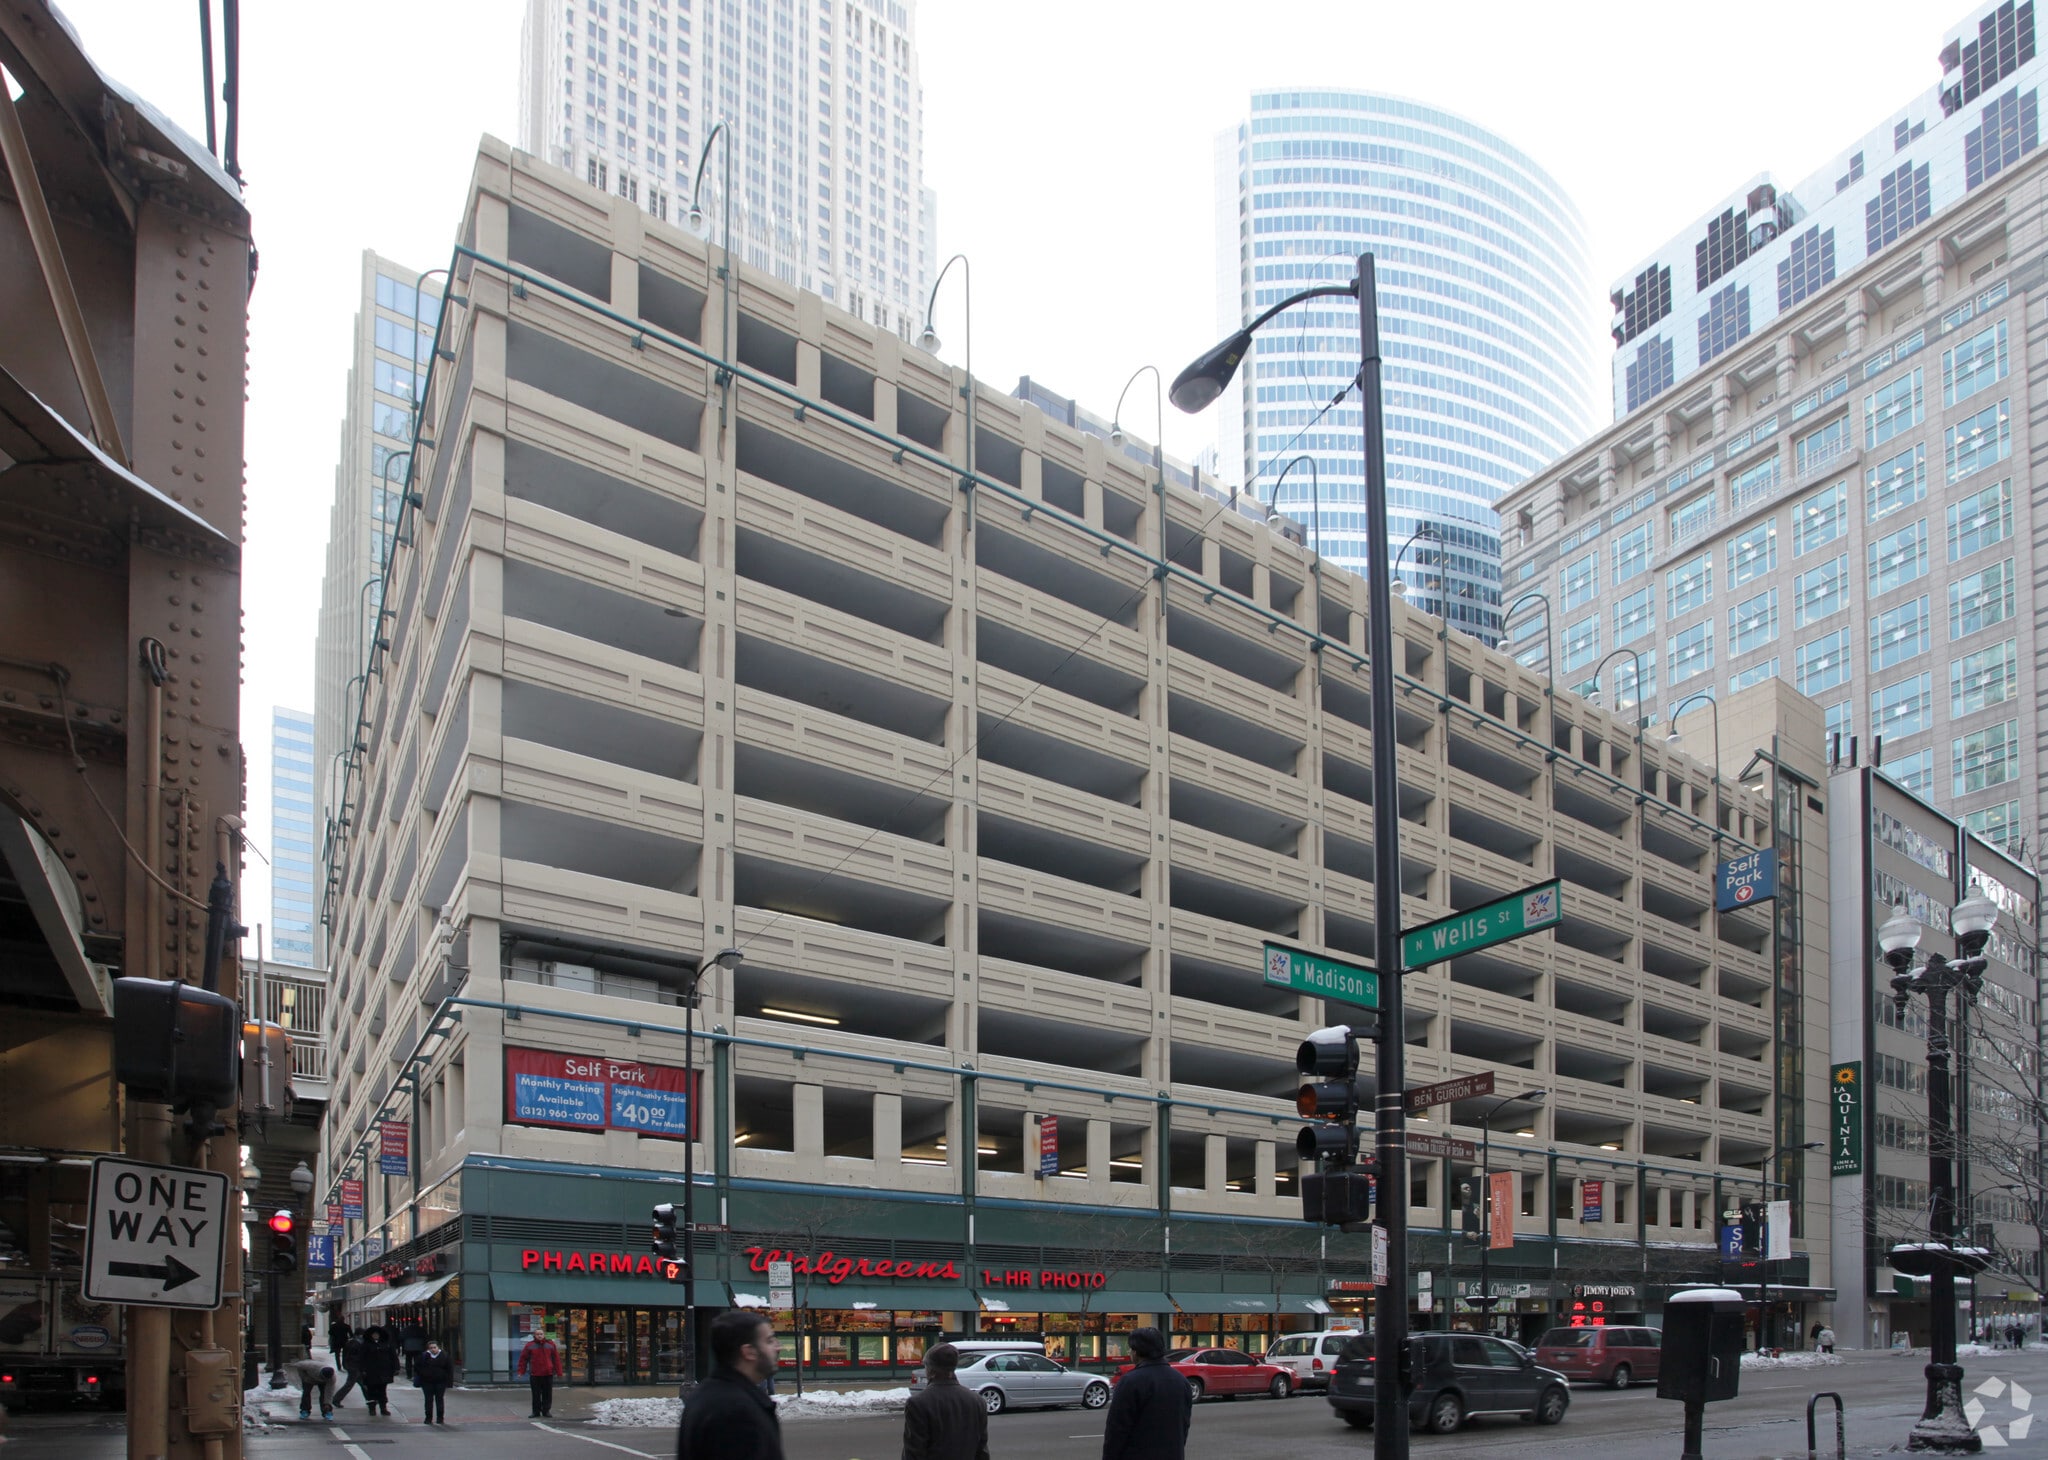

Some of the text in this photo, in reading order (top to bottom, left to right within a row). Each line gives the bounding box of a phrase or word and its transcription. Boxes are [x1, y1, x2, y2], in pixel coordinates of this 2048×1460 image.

[1728, 853, 1760, 875] Self
[1726, 868, 1762, 890] Park
[1415, 939, 1423, 952] N
[1432, 918, 1488, 951] Wells
[1498, 910, 1520, 924] St
[1294, 963, 1301, 976] W
[1304, 961, 1363, 996] Madison
[1366, 982, 1374, 995] St
[565, 1059, 646, 1084] Self Park
[520, 1076, 600, 1095] Monthly Parking
[615, 1087, 635, 1097] Night
[636, 1089, 662, 1102] Monthly
[1414, 1083, 1488, 1106] BEN GURION WAY
[1833, 1086, 1846, 1094] LA
[537, 1094, 584, 1107] Available
[520, 1106, 546, 1117] (312)
[650, 1107, 666, 1118] 00
[651, 1119, 686, 1130] Per Month
[1838, 1092, 1857, 1157] QUINTA
[1833, 1163, 1858, 1171] SUITES
[114, 1172, 207, 1212] ONE
[108, 1209, 209, 1248] WAY
[746, 1247, 961, 1284] Walgreens
[982, 1269, 1106, 1288] 1-HR PHOTO
[1583, 1285, 1636, 1297] JIMMY JOHN'S
